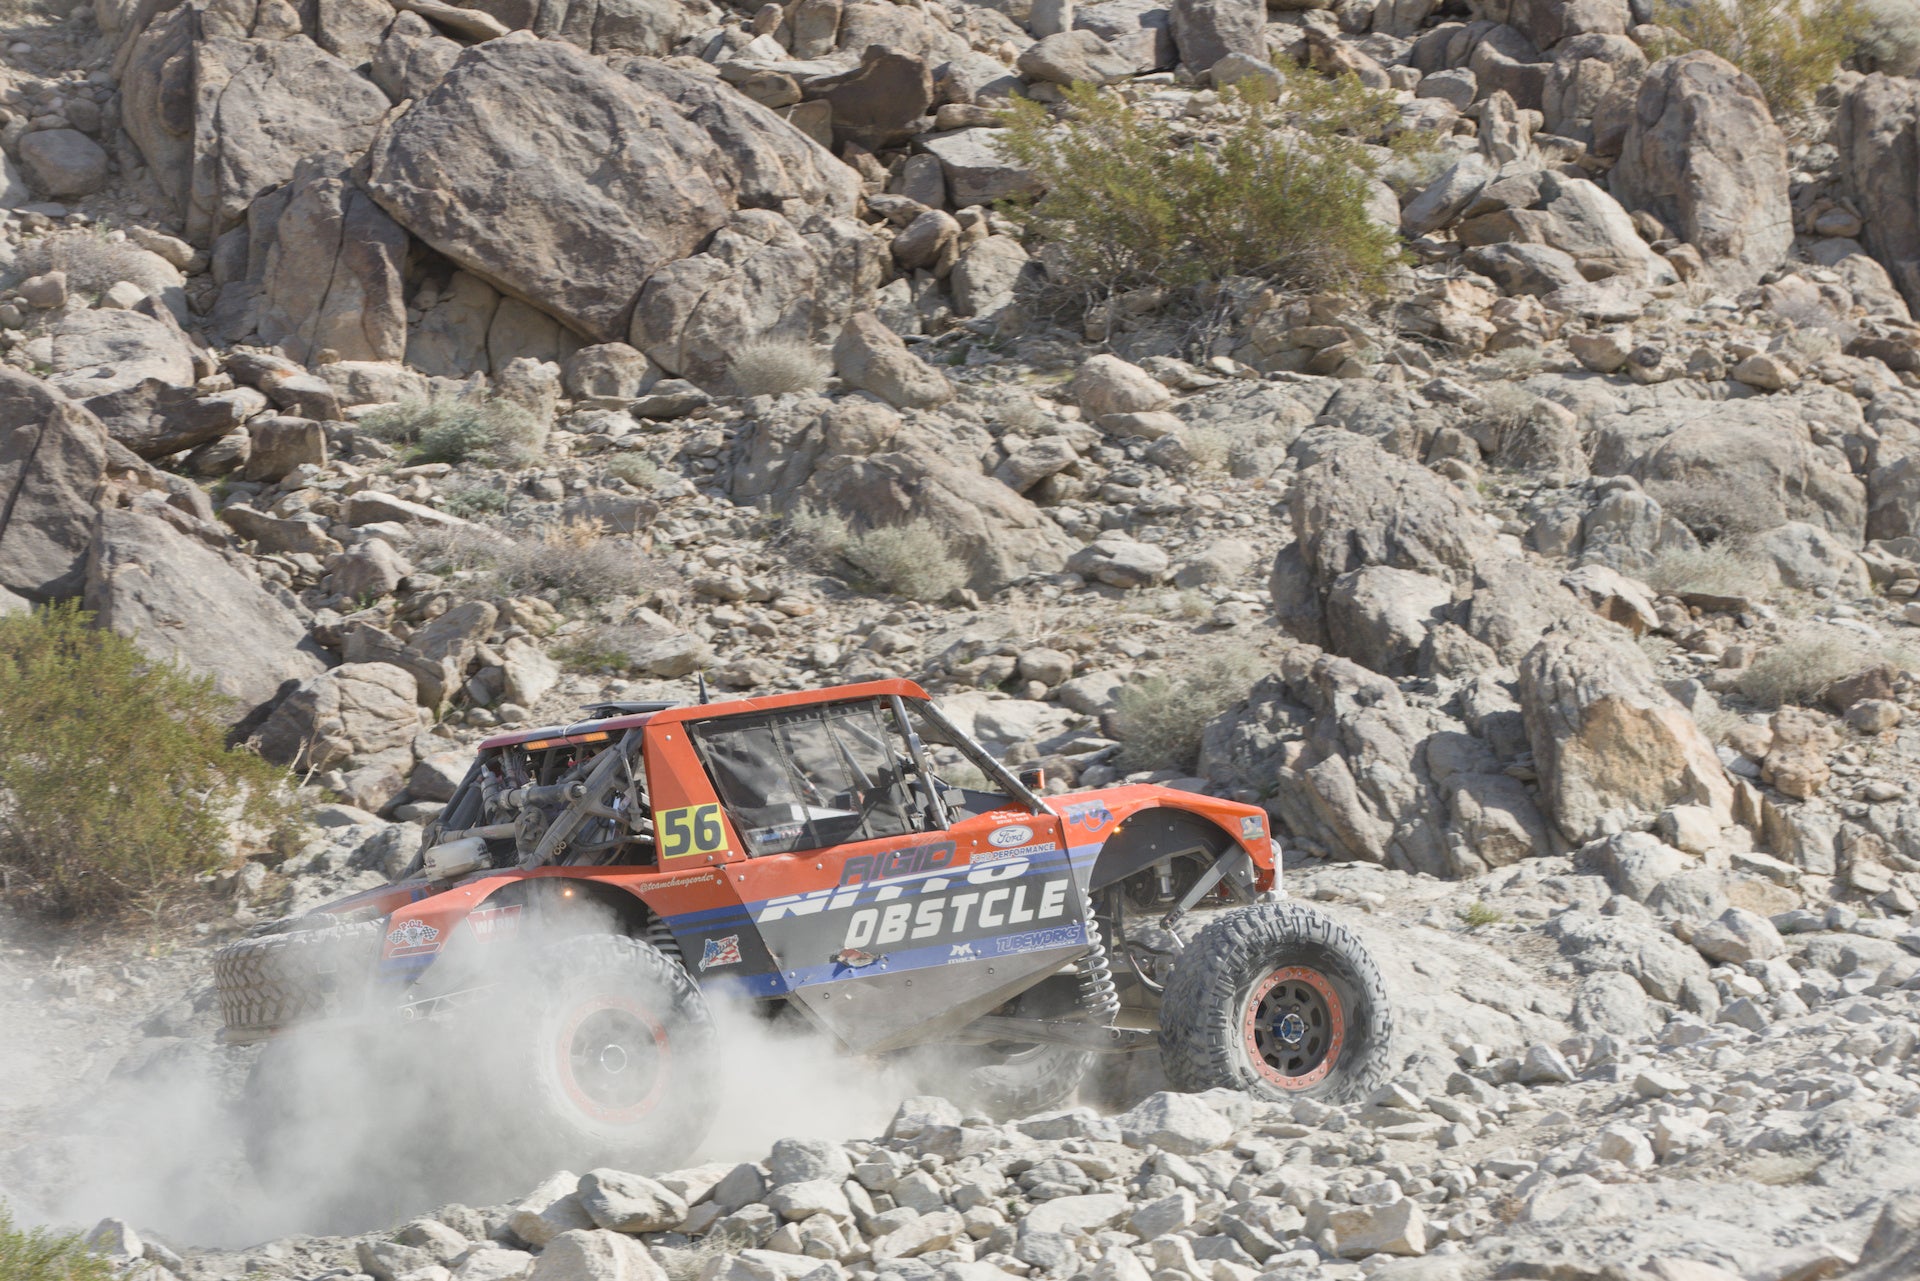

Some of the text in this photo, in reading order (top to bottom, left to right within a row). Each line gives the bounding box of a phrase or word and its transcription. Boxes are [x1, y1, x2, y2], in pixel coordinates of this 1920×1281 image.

[664, 804, 721, 857] 56
[996, 829, 1024, 844] Ford
[840, 841, 956, 886] RIGID
[993, 843, 1055, 859] PERFORMANCE
[844, 879, 1068, 949] OBSTCLE
[996, 925, 1082, 953] TUBEWORKS
